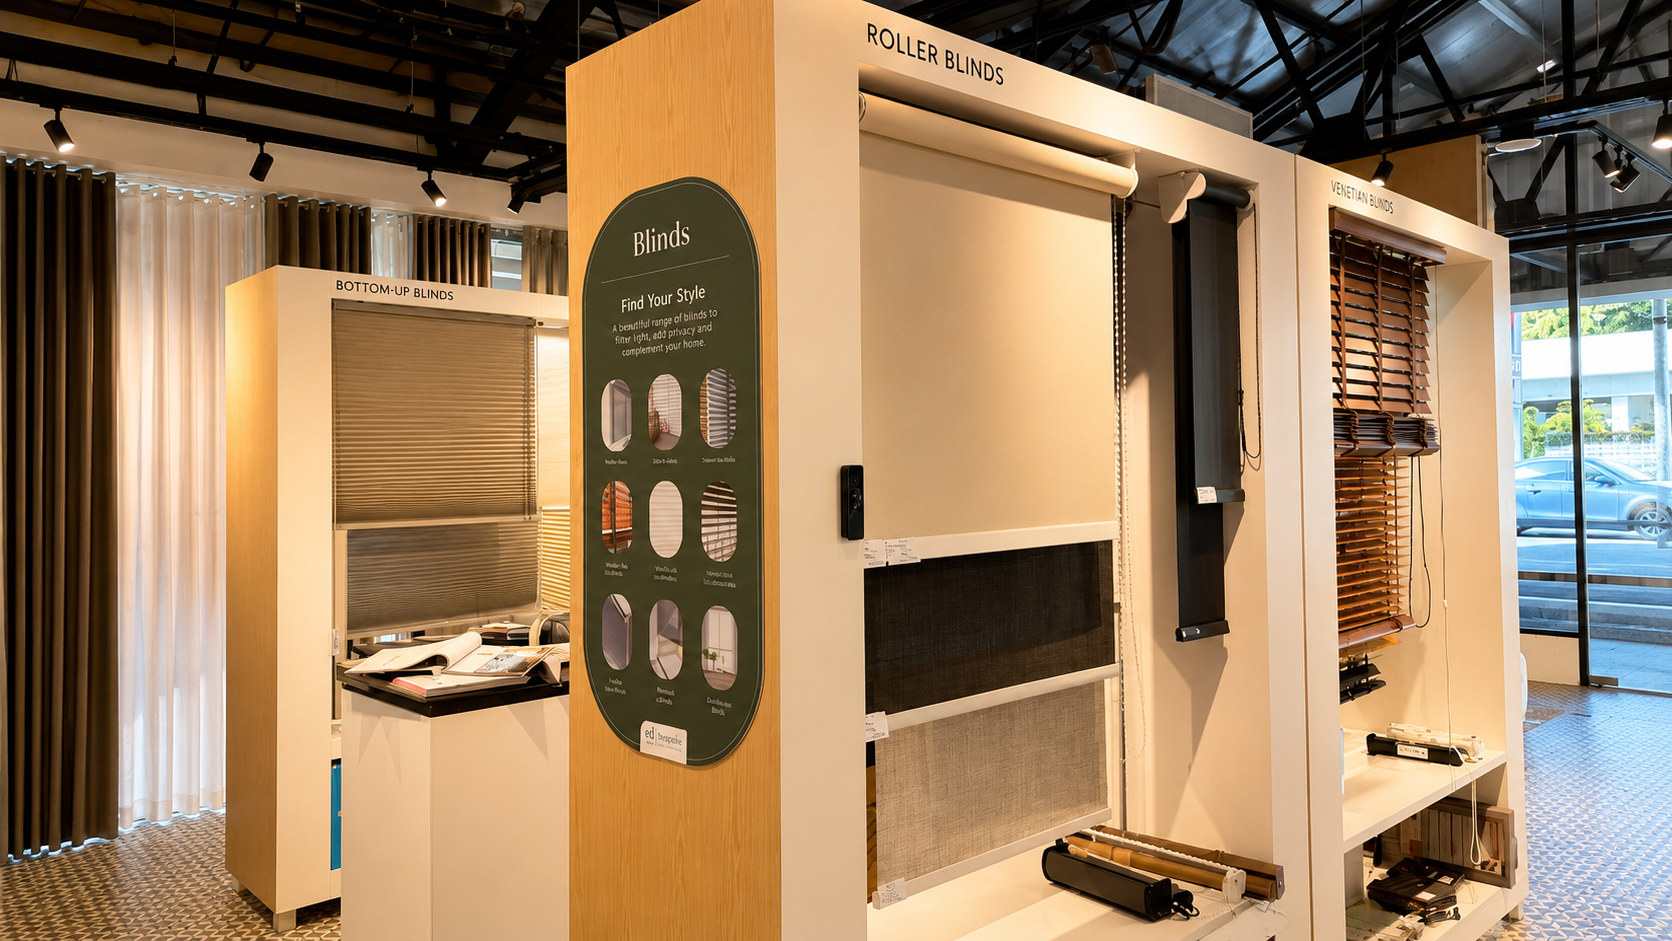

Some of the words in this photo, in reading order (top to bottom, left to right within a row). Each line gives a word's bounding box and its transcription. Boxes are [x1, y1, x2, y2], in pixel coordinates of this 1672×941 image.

[867, 22, 939, 66] ROLLER
[945, 49, 1004, 86] BLINDS
[1331, 179, 1369, 205] VENETIAN
[1369, 193, 1394, 215] BLINDS
[633, 220, 690, 257] Blinds
[336, 279, 410, 297] BOTTOM-UP
[414, 288, 454, 301] BLINDS
[621, 294, 644, 313] Find
[647, 293, 673, 308] Your
[676, 284, 706, 304] Style
[612, 324, 618, 333] A
[619, 319, 650, 332] beautiful
[651, 318, 673, 328] range
[673, 312, 682, 322] of
[683, 310, 707, 322] blinds
[709, 309, 718, 318] to
[668, 327, 695, 339] privacy
[697, 321, 713, 333] and
[621, 343, 664, 357] complement
[665, 341, 682, 353] your
[683, 338, 707, 349] home.
[644, 726, 655, 740] ed
